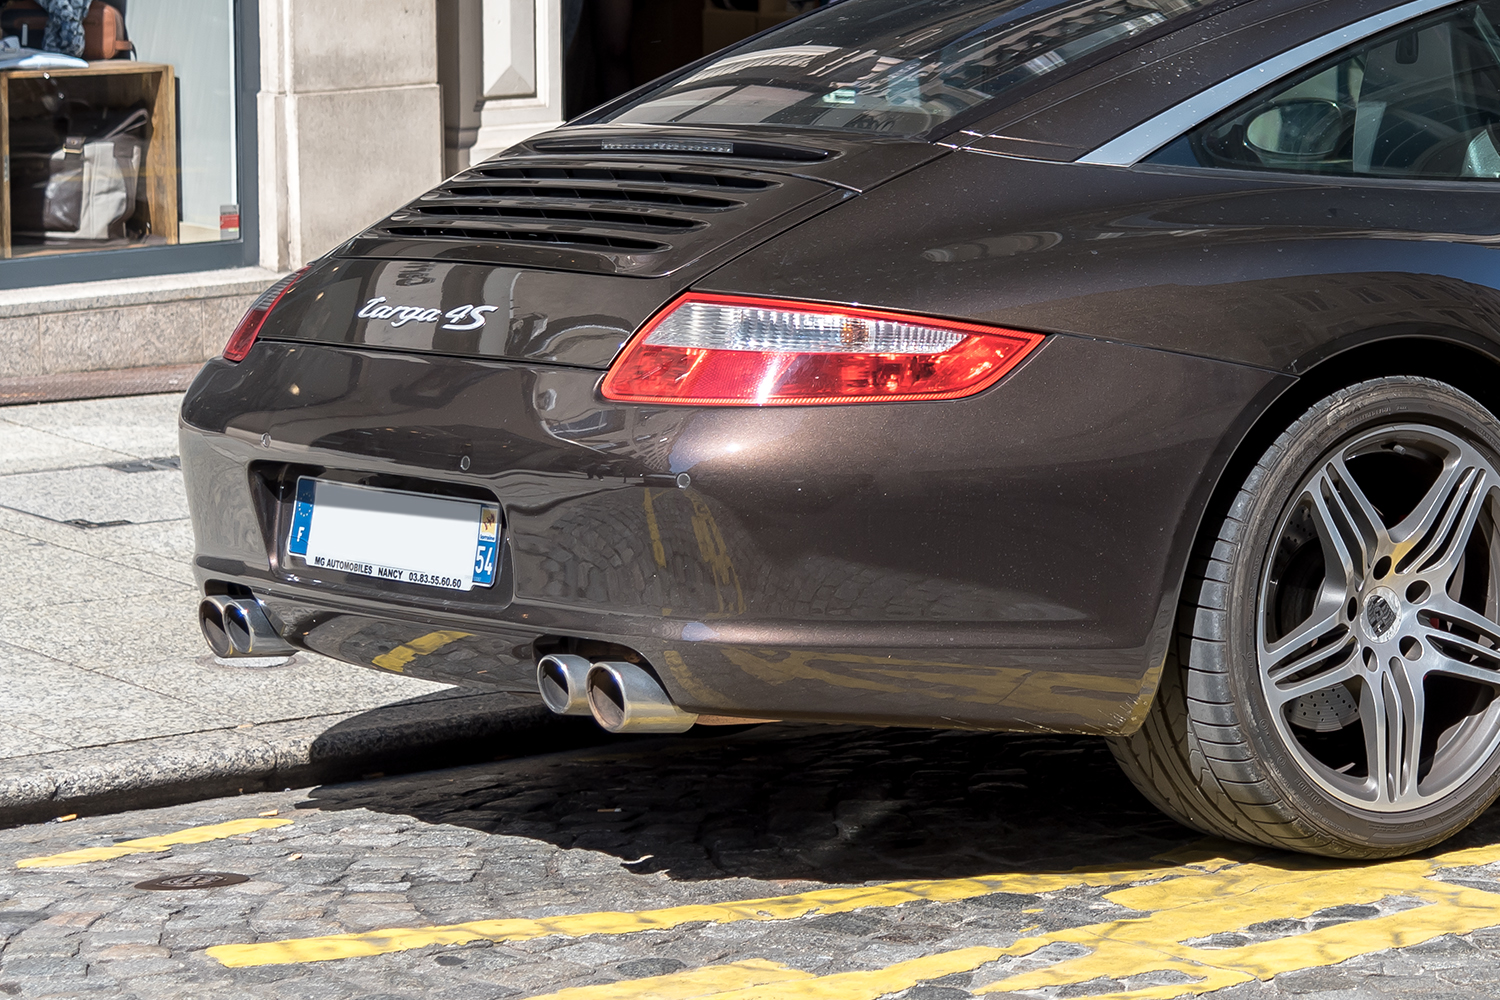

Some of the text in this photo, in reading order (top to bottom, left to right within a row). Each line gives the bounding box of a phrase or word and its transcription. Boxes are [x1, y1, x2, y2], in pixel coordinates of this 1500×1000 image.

[442, 304, 499, 330] 4S
[296, 526, 305, 543] F
[314, 556, 326, 567] MG
[326, 558, 373, 575] AUTOMOBILES
[377, 567, 404, 580] NANCY
[408, 572, 462, 588] 03.83.55.60.60
[475, 545, 493, 576] 54
